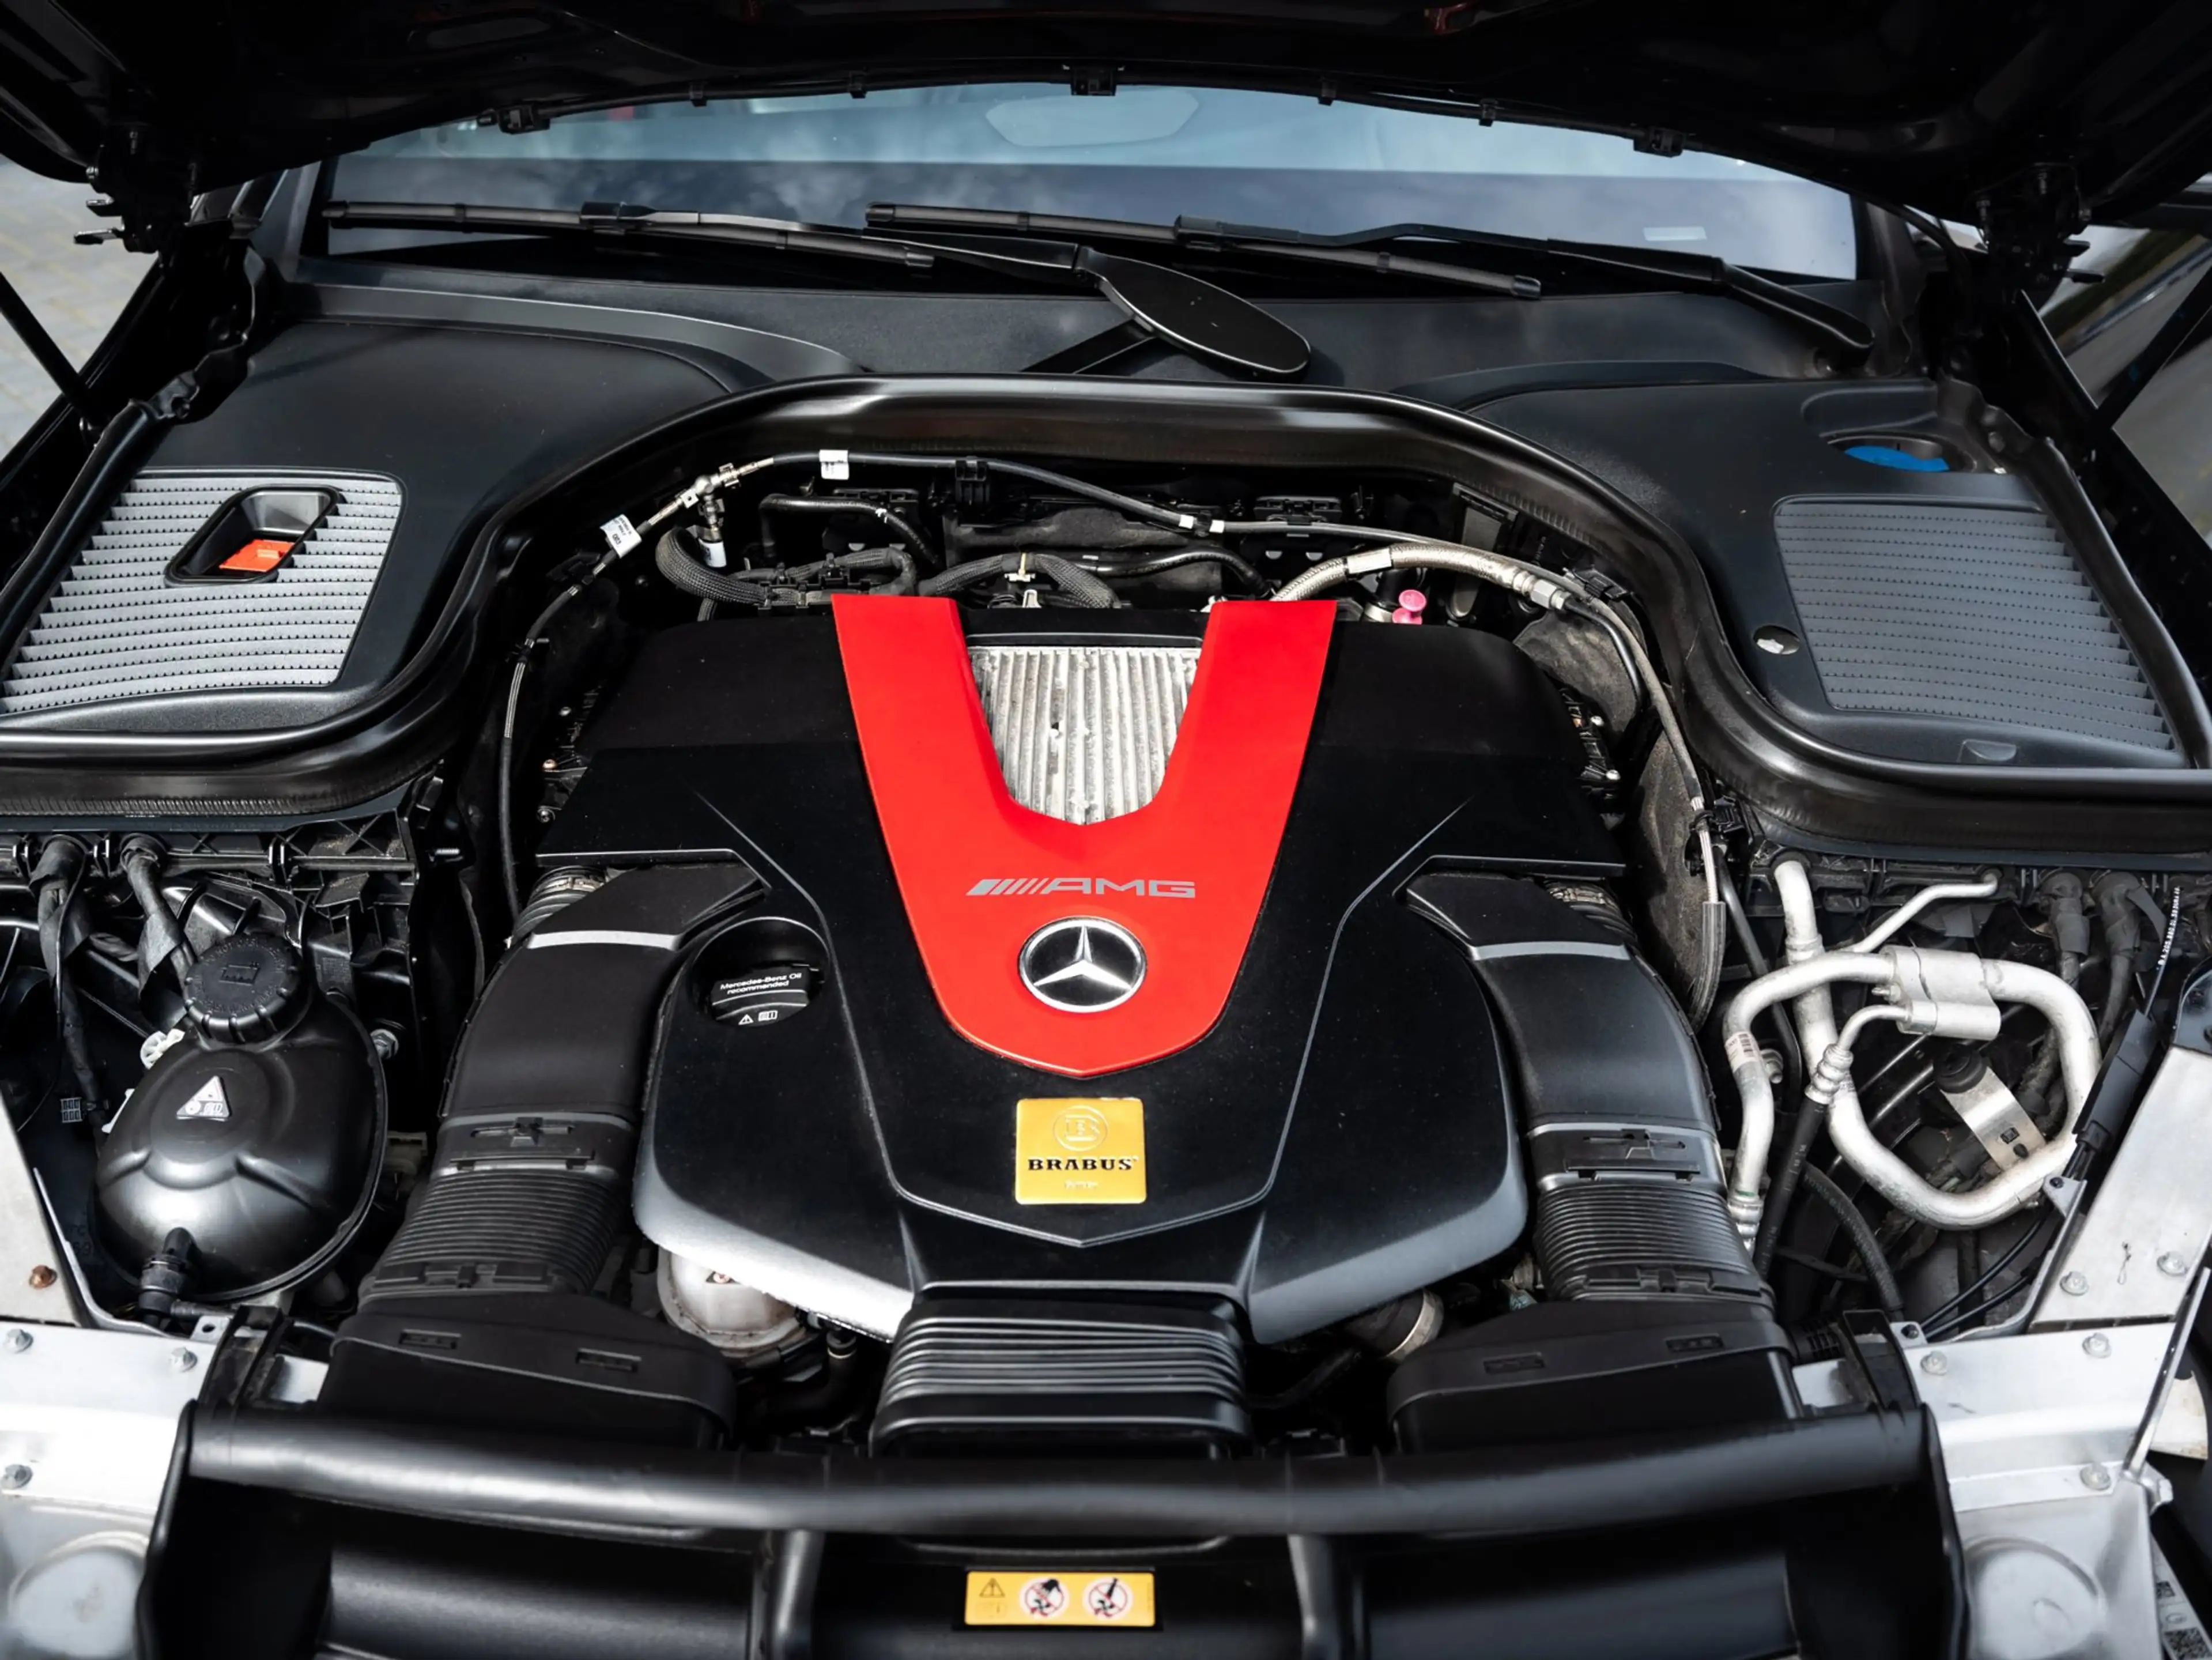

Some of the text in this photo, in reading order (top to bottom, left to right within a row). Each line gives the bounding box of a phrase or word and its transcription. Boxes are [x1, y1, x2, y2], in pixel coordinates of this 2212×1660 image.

[1040, 877, 1196, 899] AMG
[720, 975, 787, 990] Mercedes-Benz
[727, 980, 790, 994] recommended
[1027, 1158, 1133, 1171] BRABUS
